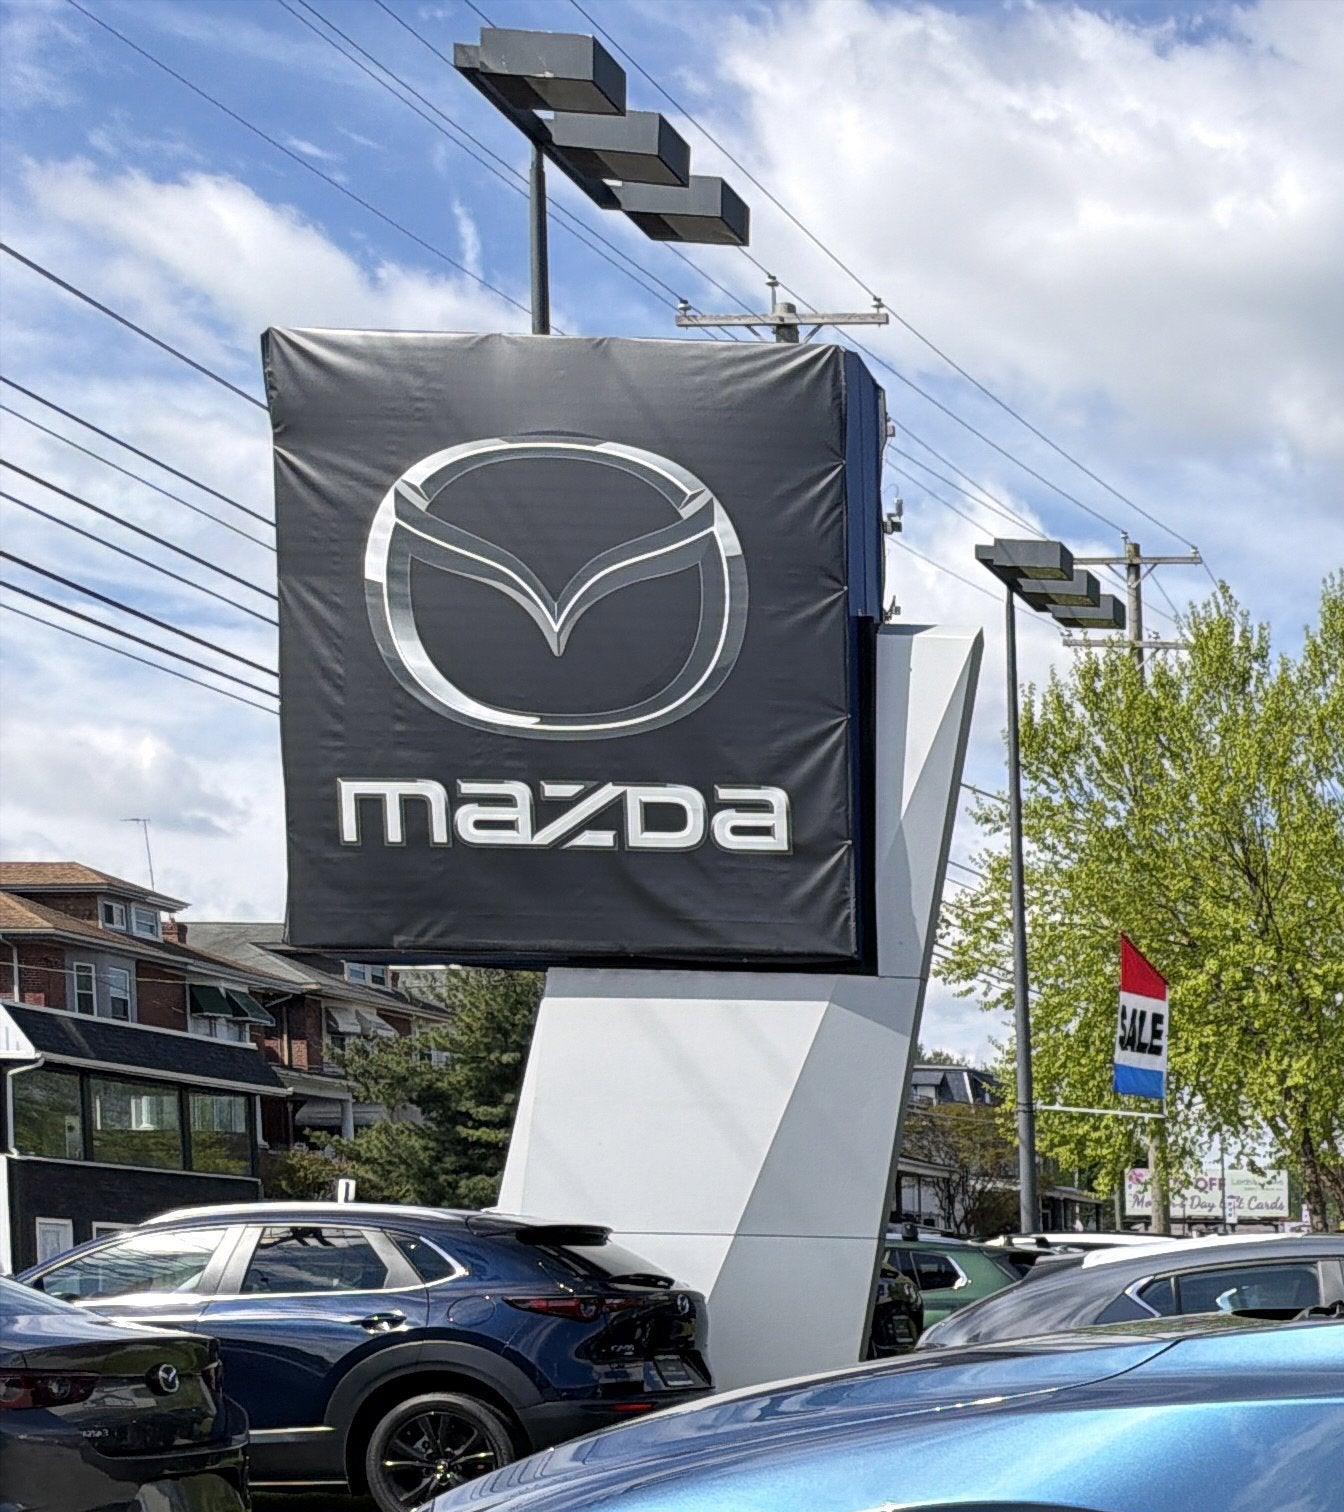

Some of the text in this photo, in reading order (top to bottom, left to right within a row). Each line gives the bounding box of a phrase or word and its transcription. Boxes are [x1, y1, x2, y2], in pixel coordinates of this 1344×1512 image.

[337, 777, 793, 855] mazda
[1119, 1004, 1165, 1056] SALE
[1189, 1195, 1216, 1212] Day
[1247, 1195, 1285, 1211] Cards
